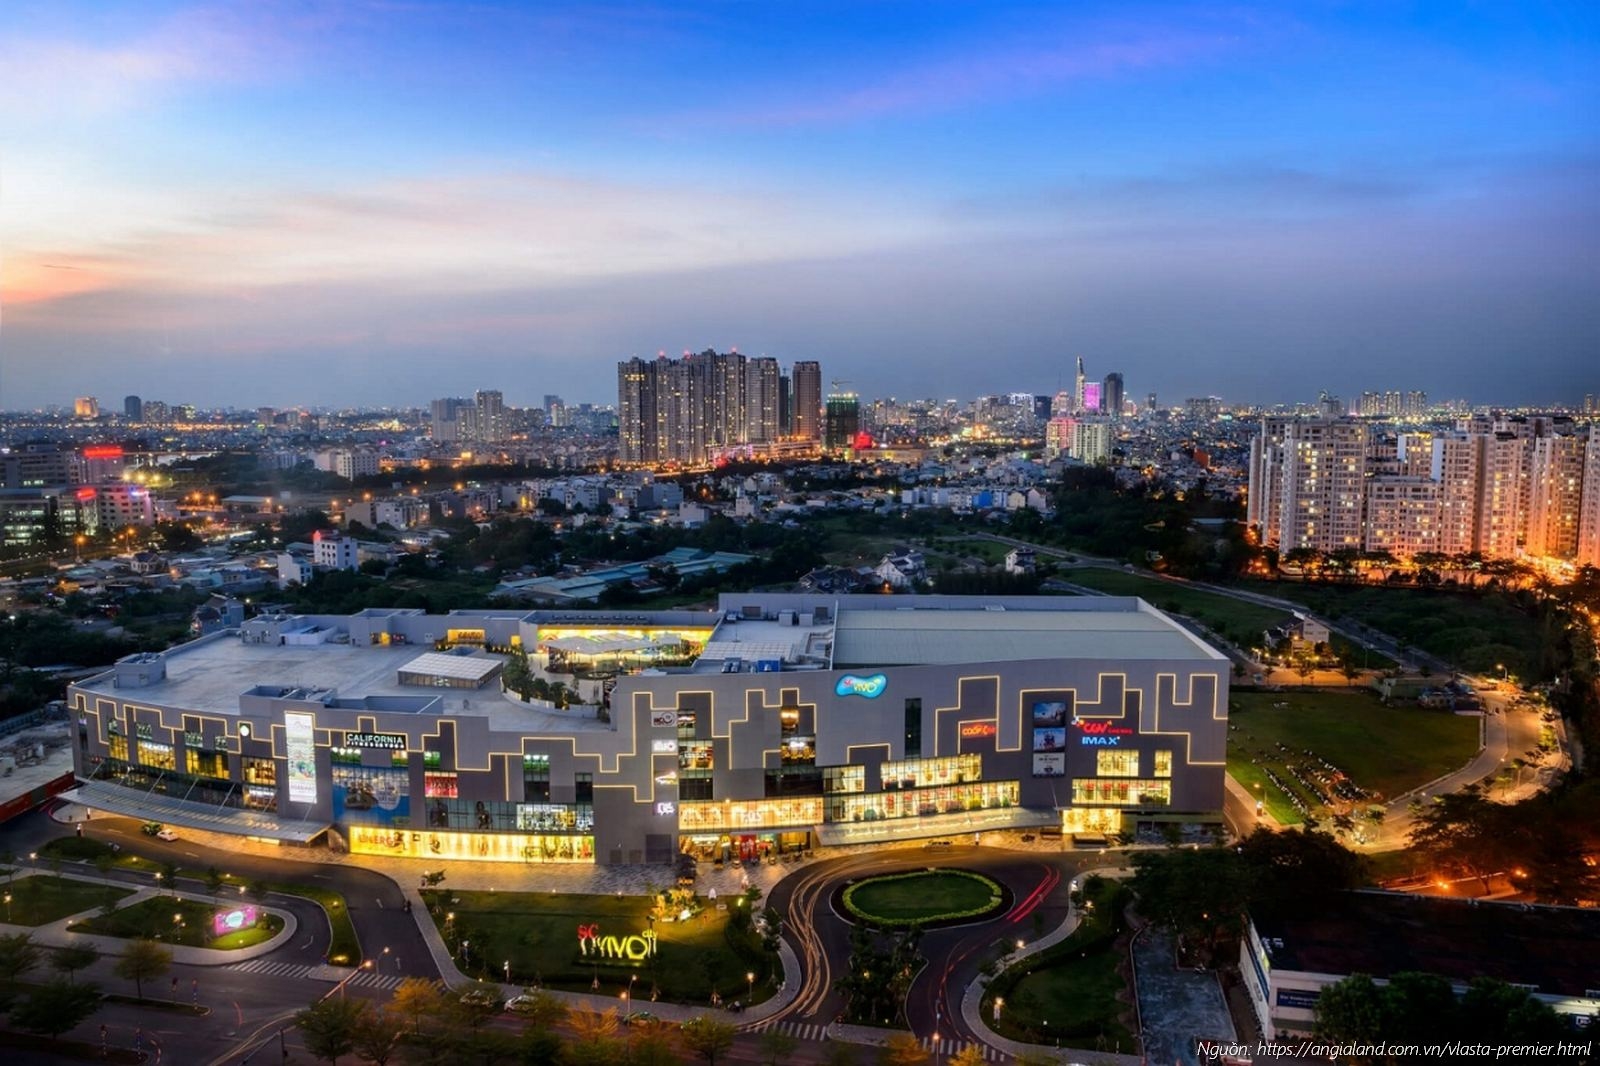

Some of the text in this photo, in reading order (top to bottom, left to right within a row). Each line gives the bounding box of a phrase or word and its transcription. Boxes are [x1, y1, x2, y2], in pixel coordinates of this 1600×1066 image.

[1083, 722, 1107, 734] CGV
[347, 734, 403, 744] CALIFORNIA
[1082, 736, 1117, 745] IMAX
[578, 924, 598, 940] SC
